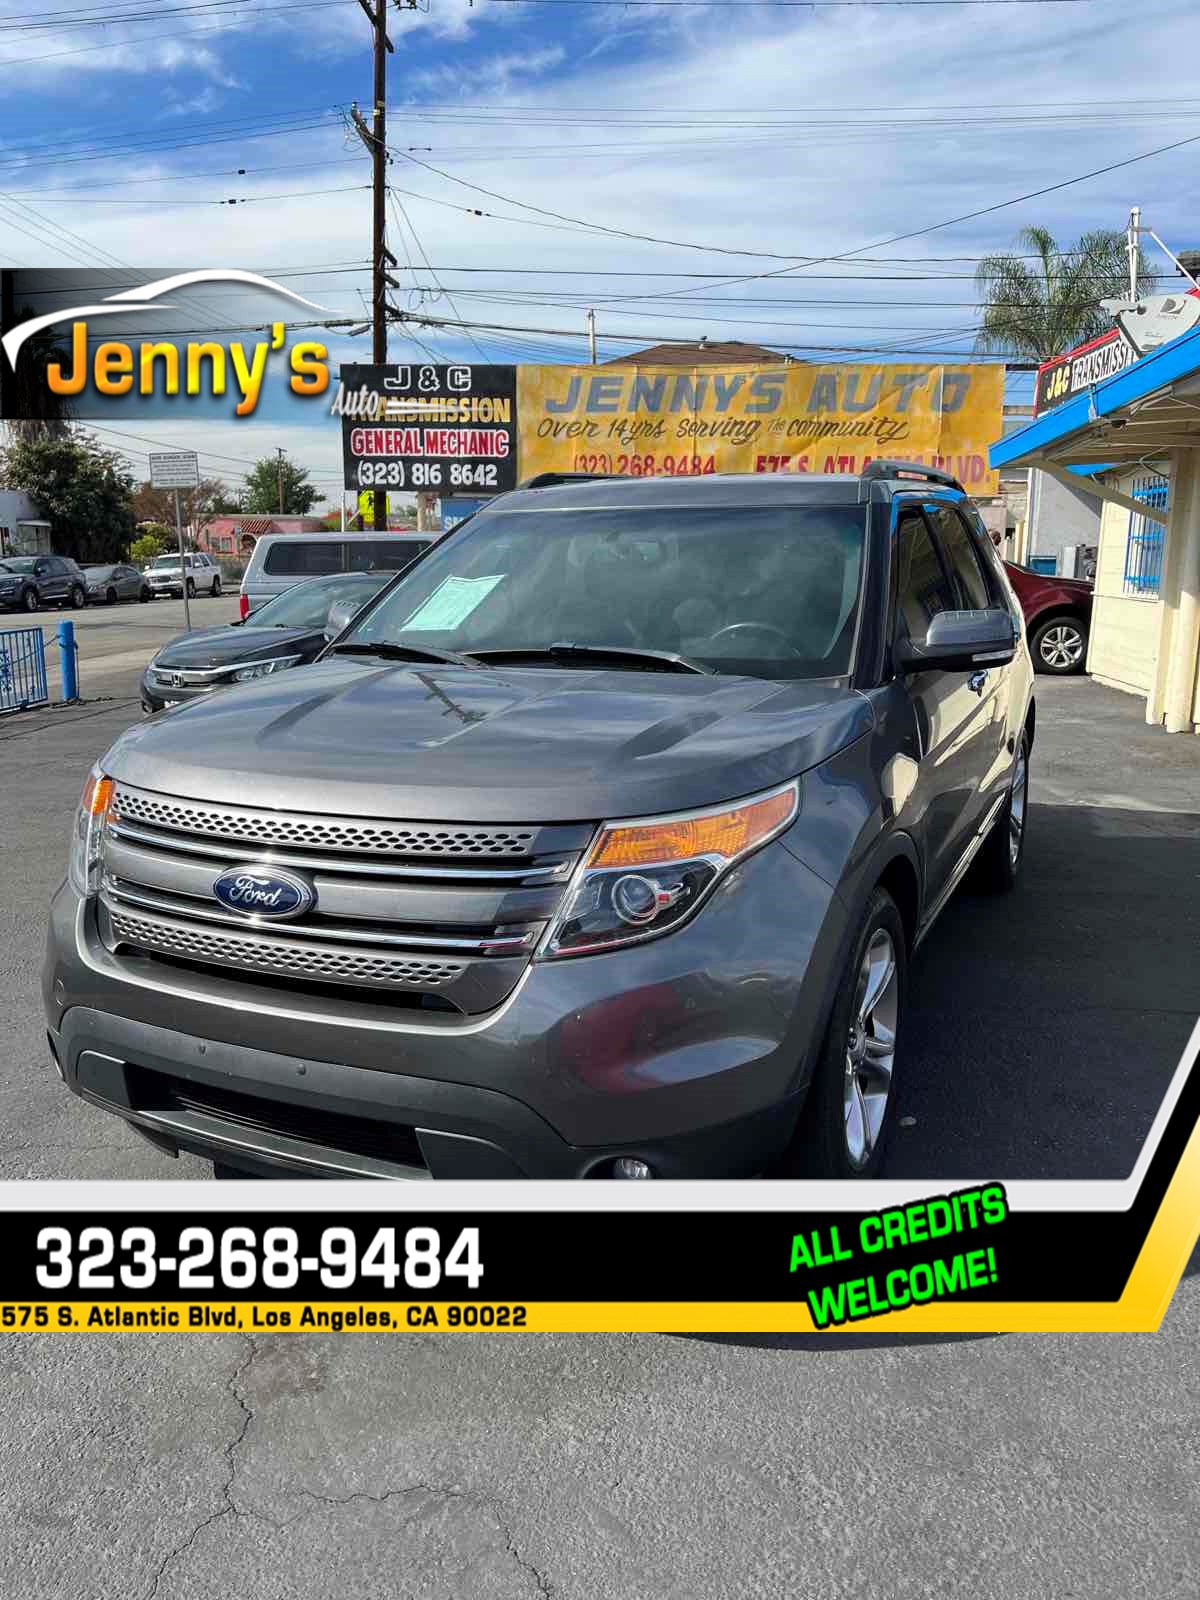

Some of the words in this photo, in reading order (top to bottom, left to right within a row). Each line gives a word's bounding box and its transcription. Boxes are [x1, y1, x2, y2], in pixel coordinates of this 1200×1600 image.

[384, 366, 411, 390] J
[418, 366, 440, 391] &
[447, 366, 471, 391] C
[806, 372, 972, 413] AUTO
[352, 428, 423, 457] GENERAL
[424, 428, 508, 458] MECHANIC
[537, 418, 601, 438] Over
[677, 416, 762, 445] Serving
[786, 417, 911, 446] community
[358, 461, 405, 487] (323)
[411, 464, 442, 486] 816
[450, 464, 498, 486] 8642
[574, 455, 613, 474] (323)
[617, 454, 716, 475] 268-9484
[230, 876, 282, 906] Ford
